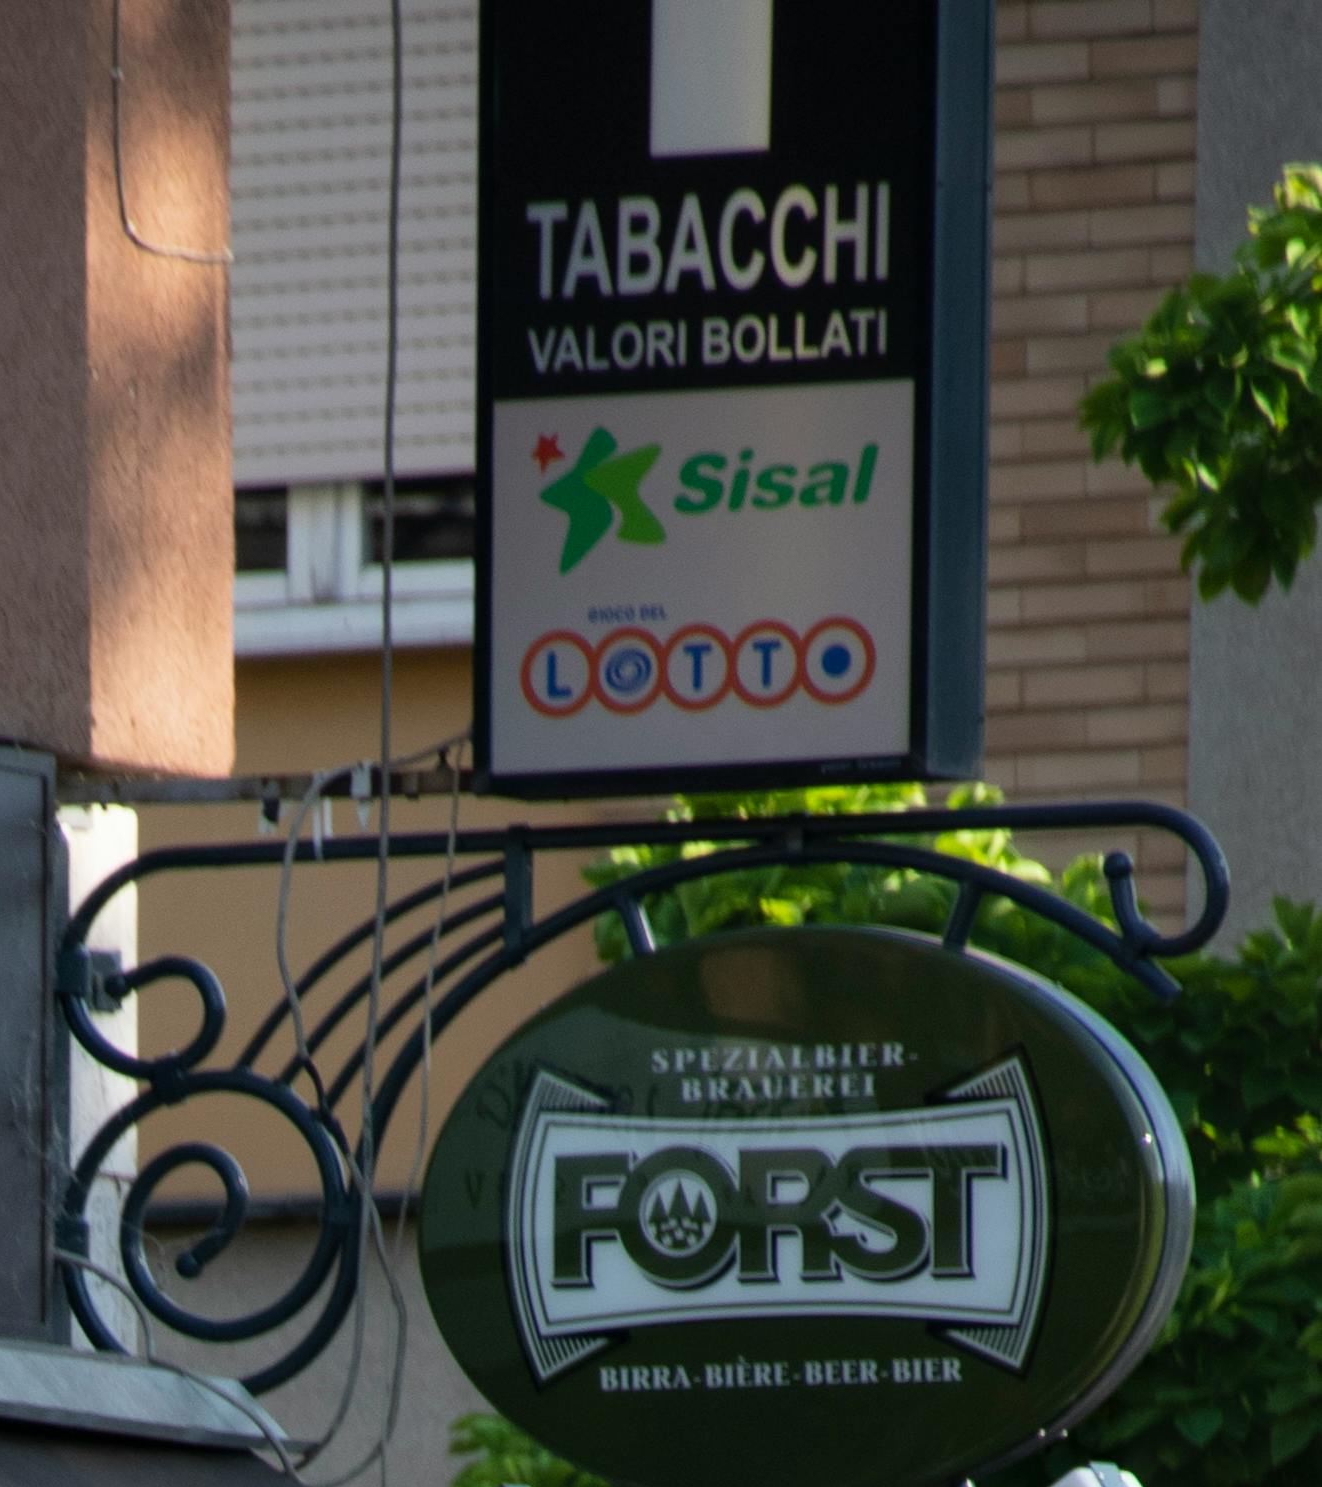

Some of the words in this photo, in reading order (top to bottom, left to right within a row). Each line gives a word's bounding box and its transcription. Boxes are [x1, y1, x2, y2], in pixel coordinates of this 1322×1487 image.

[527, 183, 890, 299] TABACCHI
[528, 320, 686, 373] VALORI
[702, 309, 888, 364] BOLLATI
[674, 443, 878, 515] Sisal
[651, 1042, 918, 1073] SPEZIALBIER-
[682, 1073, 876, 1101] BRAUEREI
[552, 1144, 1008, 1290] FORST
